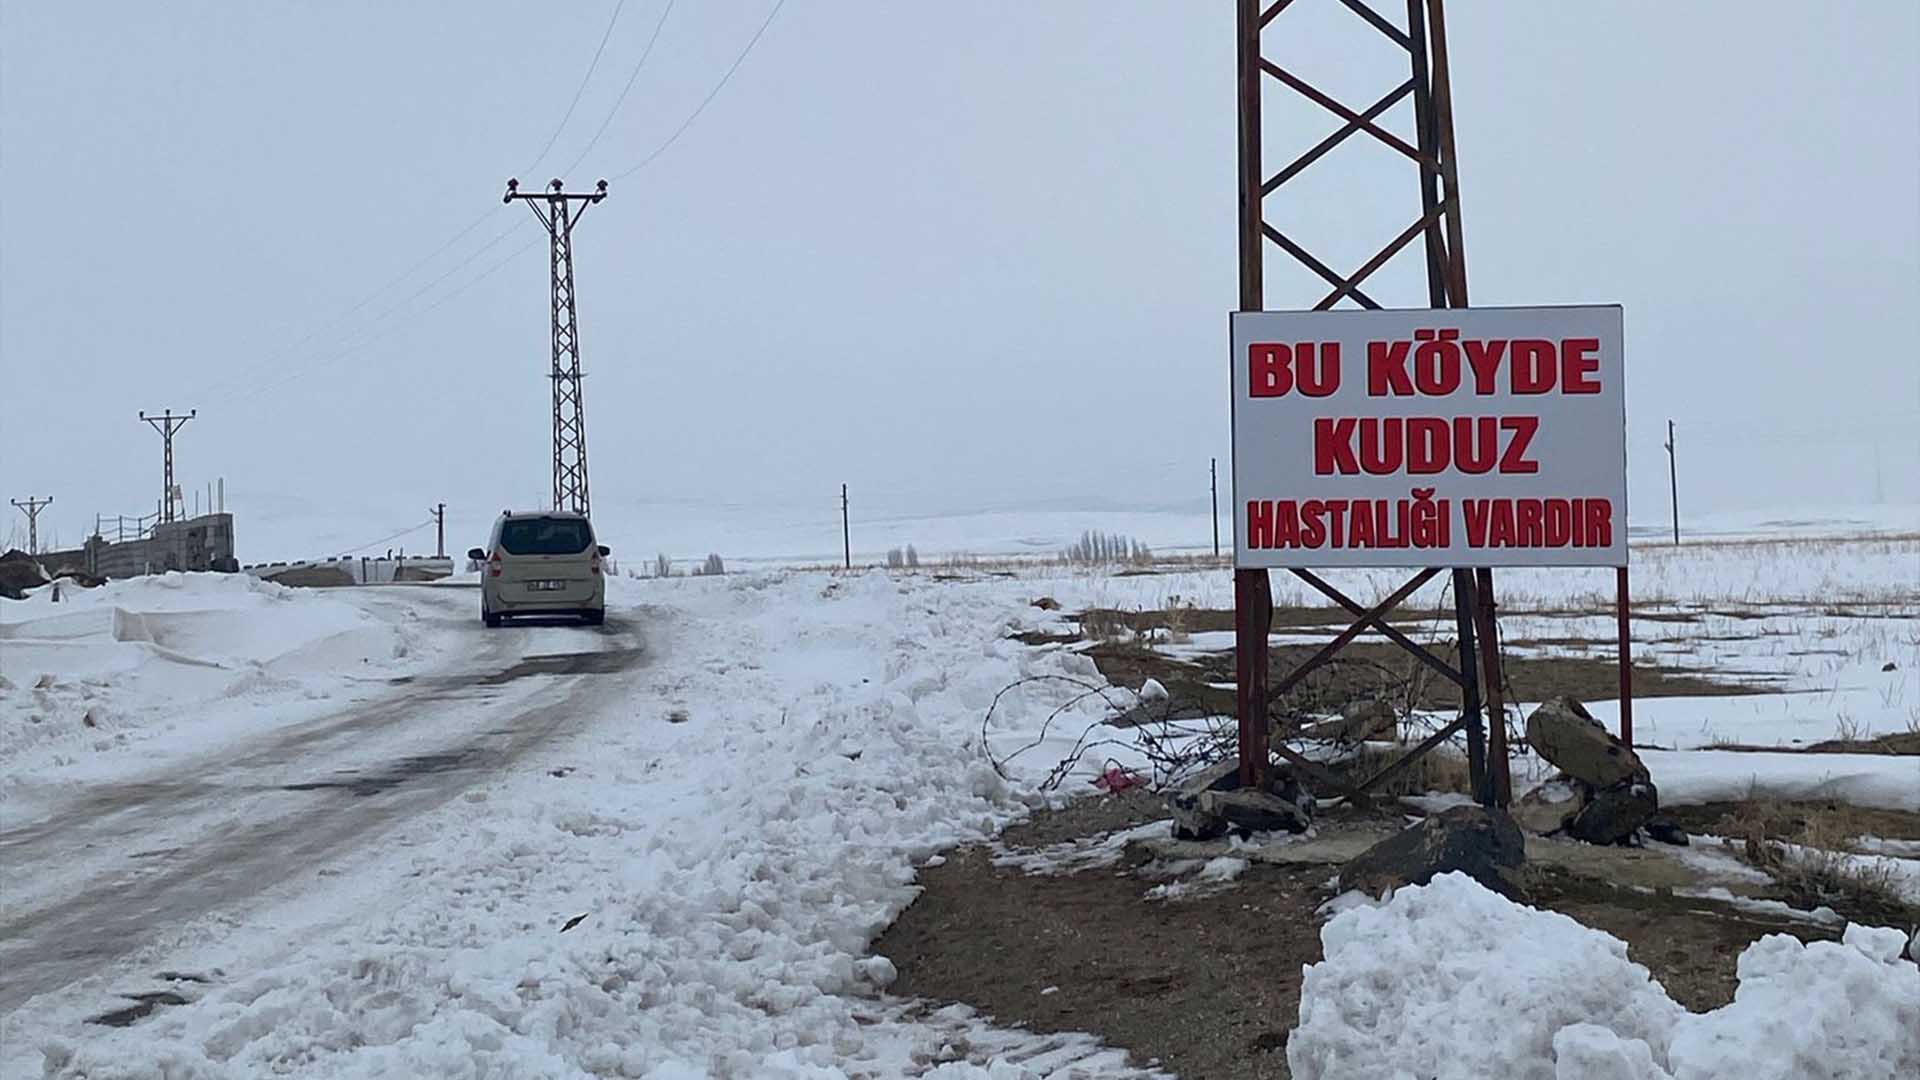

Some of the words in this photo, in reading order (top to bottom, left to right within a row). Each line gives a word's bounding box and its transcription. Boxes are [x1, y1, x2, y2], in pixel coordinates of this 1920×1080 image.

[1248, 342, 1341, 397] BU
[1367, 328, 1602, 396] KÖYDE
[1314, 416, 1539, 475] KUDUZ
[1247, 488, 1450, 549] HASTALIĞI
[1463, 498, 1613, 548] VARDIR
